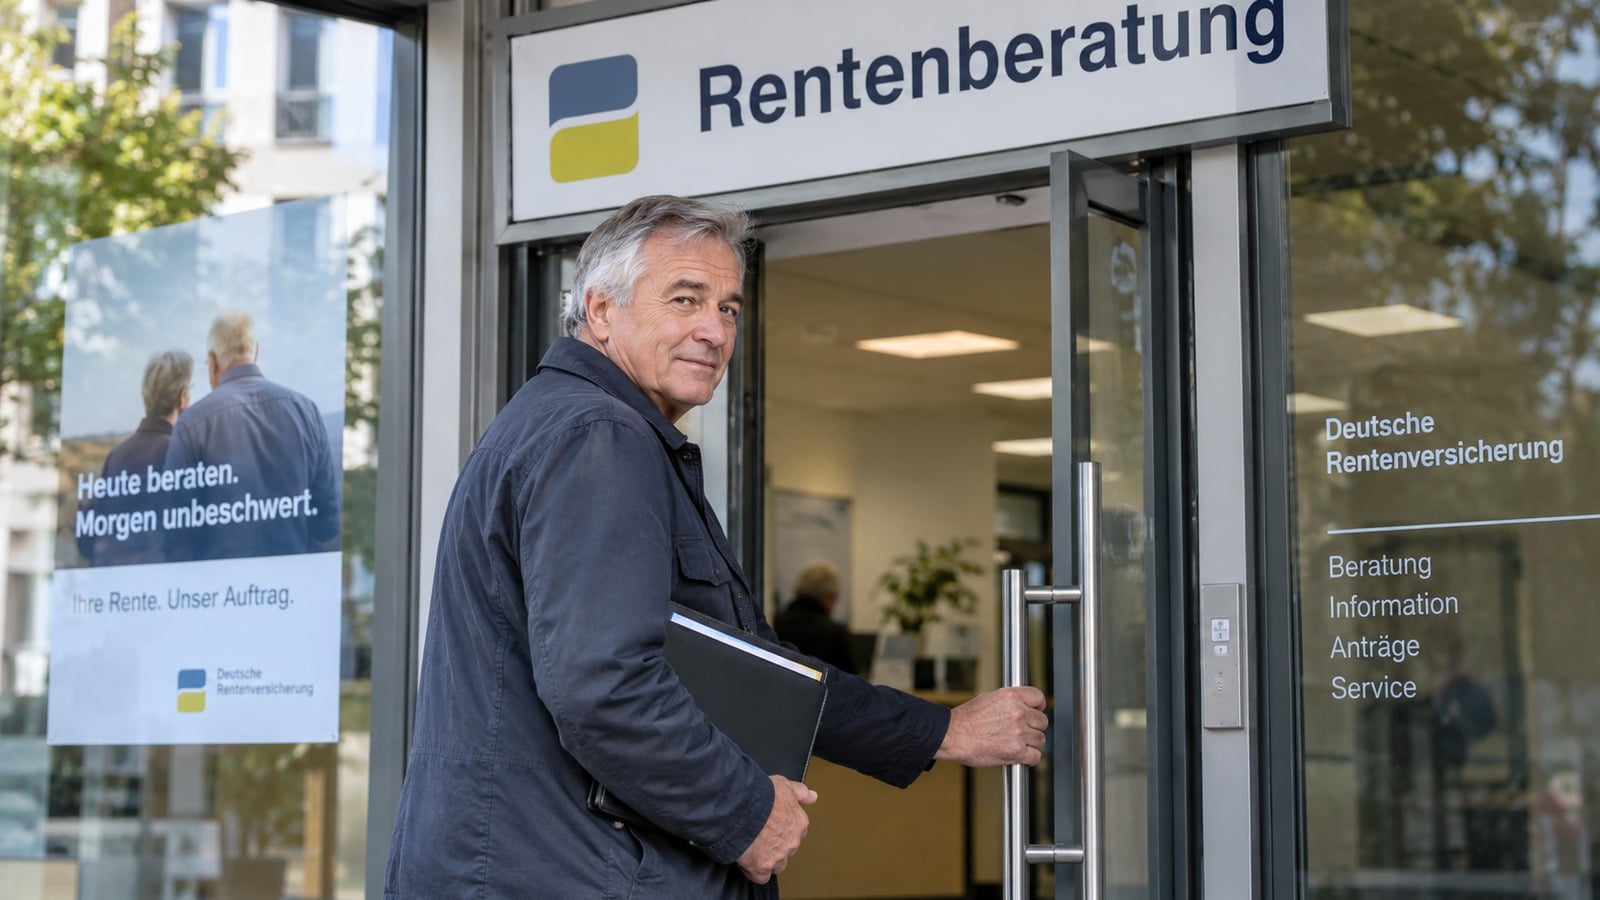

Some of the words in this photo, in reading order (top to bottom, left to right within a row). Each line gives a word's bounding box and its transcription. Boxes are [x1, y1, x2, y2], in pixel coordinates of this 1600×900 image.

[700, 0, 1284, 133] Rentenberatung
[1325, 411, 1435, 441] Deutsche
[1327, 439, 1564, 474] Rentenversicherung
[77, 470, 142, 500] Heute
[147, 461, 239, 494] beraten.
[75, 509, 157, 541] Morgen
[162, 488, 318, 530] unbeschwert.
[1328, 554, 1432, 580] Beratung
[73, 593, 104, 615] Ihre
[109, 591, 161, 613] Rente.
[167, 588, 219, 610] Unser
[224, 584, 294, 610] Auftrag.
[1329, 591, 1459, 619] Information
[1330, 635, 1420, 663] Anträge
[216, 667, 262, 680] Deutsche
[1331, 675, 1417, 699] Service
[216, 683, 314, 697] Rentenversicherung
